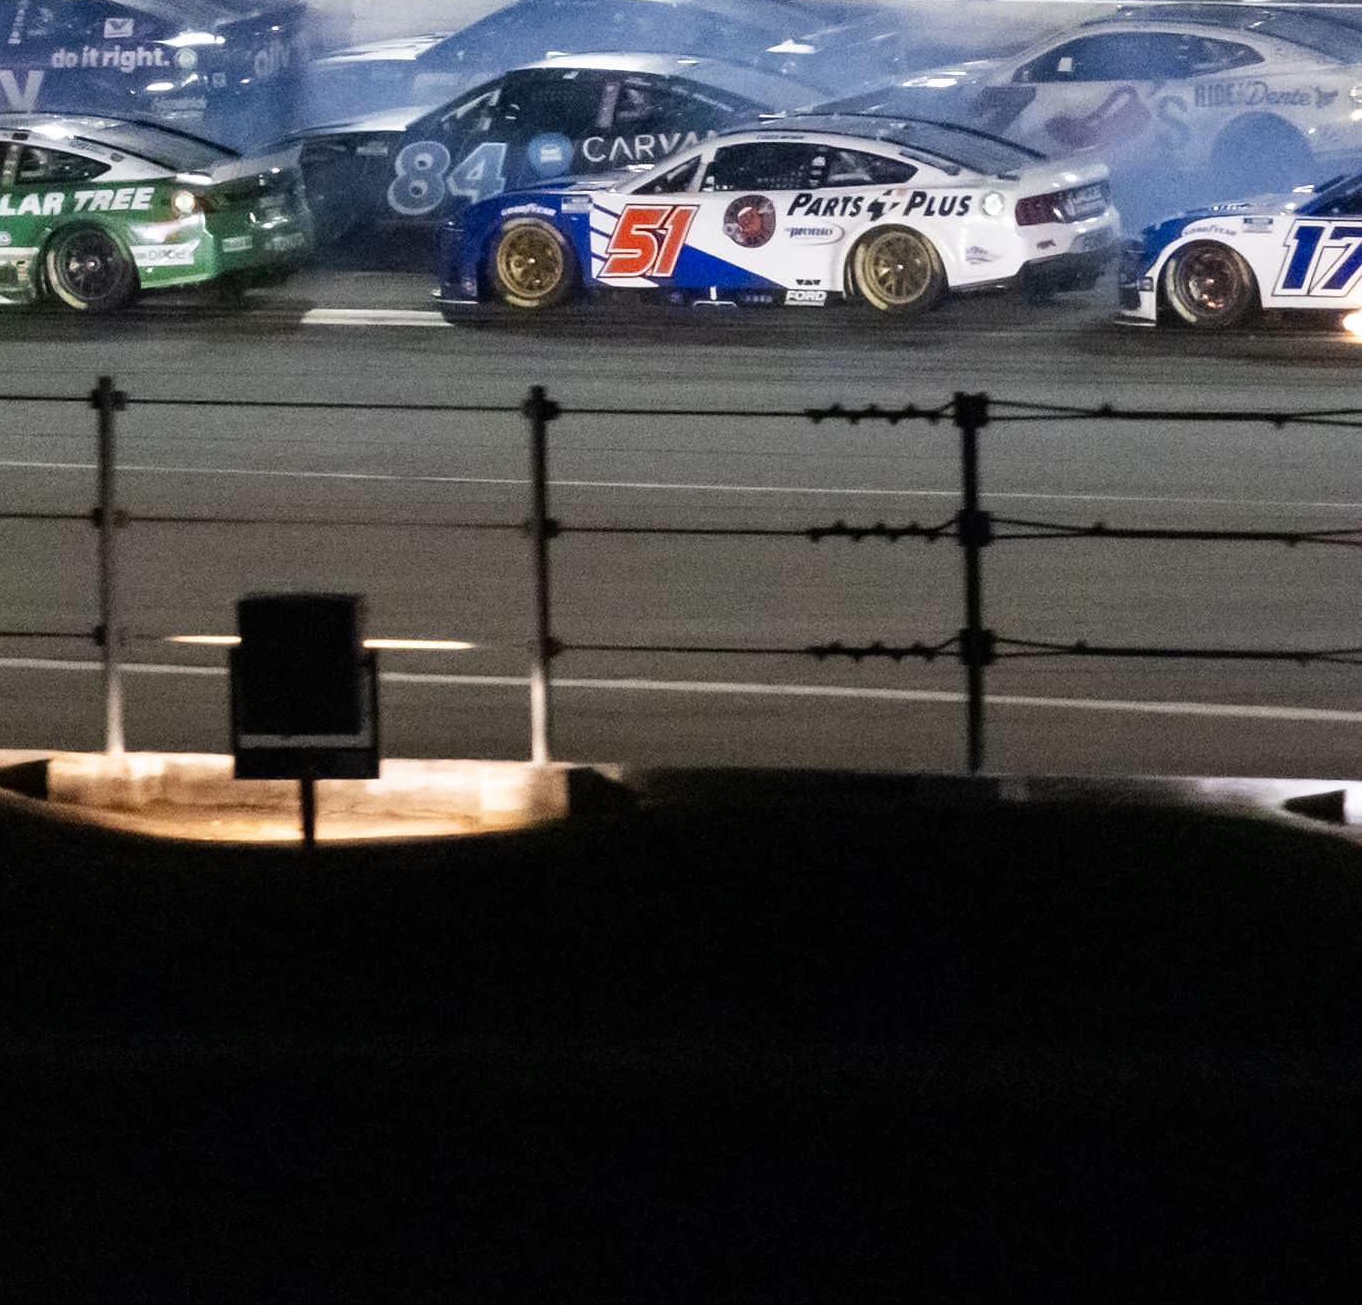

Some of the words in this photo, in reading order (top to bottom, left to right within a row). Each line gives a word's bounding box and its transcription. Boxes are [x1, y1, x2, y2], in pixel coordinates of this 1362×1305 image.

[51, 48, 78, 68] do
[81, 46, 99, 67] it
[101, 45, 171, 74] right.
[73, 187, 155, 212] TREE
[387, 140, 508, 216] 84
[596, 203, 701, 278] 51
[1271, 219, 1362, 297] 17
[785, 290, 828, 302] FORD
